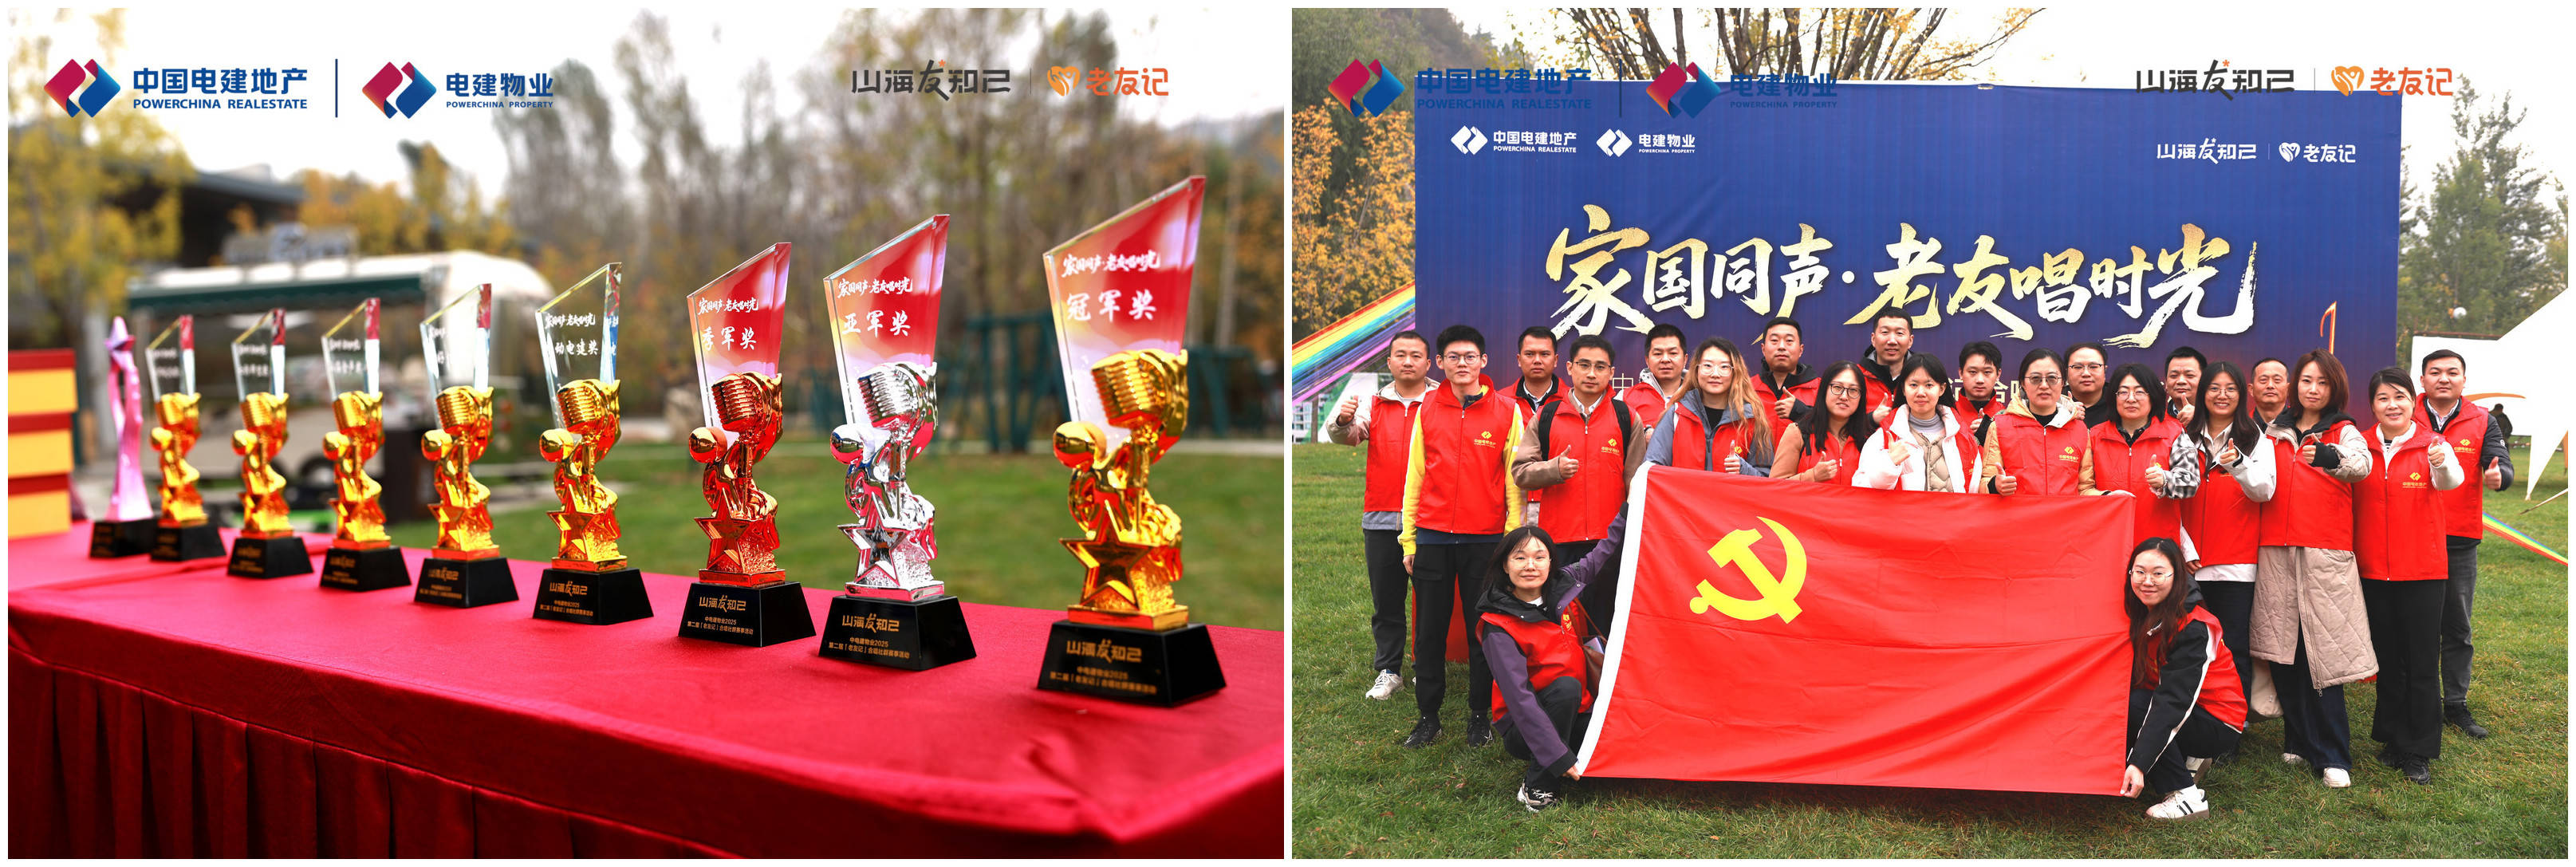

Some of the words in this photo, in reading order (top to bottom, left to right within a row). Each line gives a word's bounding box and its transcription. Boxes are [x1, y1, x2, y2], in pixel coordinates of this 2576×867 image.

[1493, 131, 1577, 146] 中国电建地产
[1639, 134, 1696, 148] 电建物业
[2157, 137, 2256, 164] 山海友知己
[2303, 144, 2356, 163] 老友记
[1546, 204, 2257, 349] 家国同声·老友唱时光
[1066, 289, 1156, 322] 冠军奖
[842, 310, 912, 338] 亚军奖
[702, 326, 756, 351] 季军奖
[699, 594, 746, 613] 山海友知己
[842, 613, 900, 633] 山海友知己
